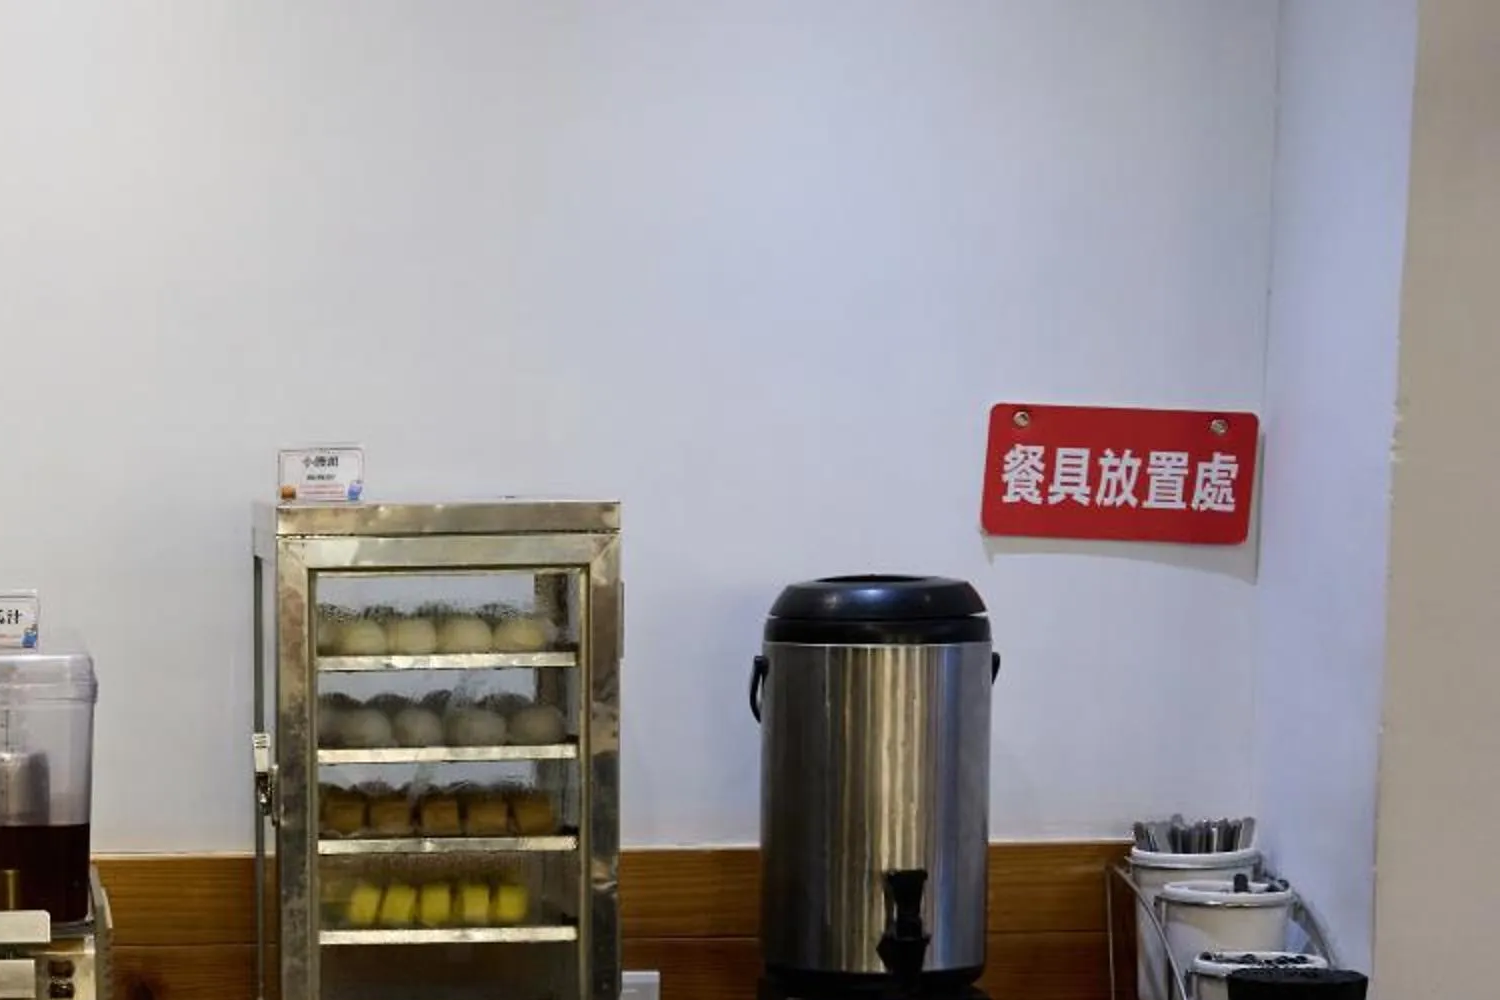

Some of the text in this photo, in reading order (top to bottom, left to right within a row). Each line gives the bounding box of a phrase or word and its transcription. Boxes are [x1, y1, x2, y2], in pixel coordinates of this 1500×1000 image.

[1000, 443, 1239, 513] 餐具放置處
